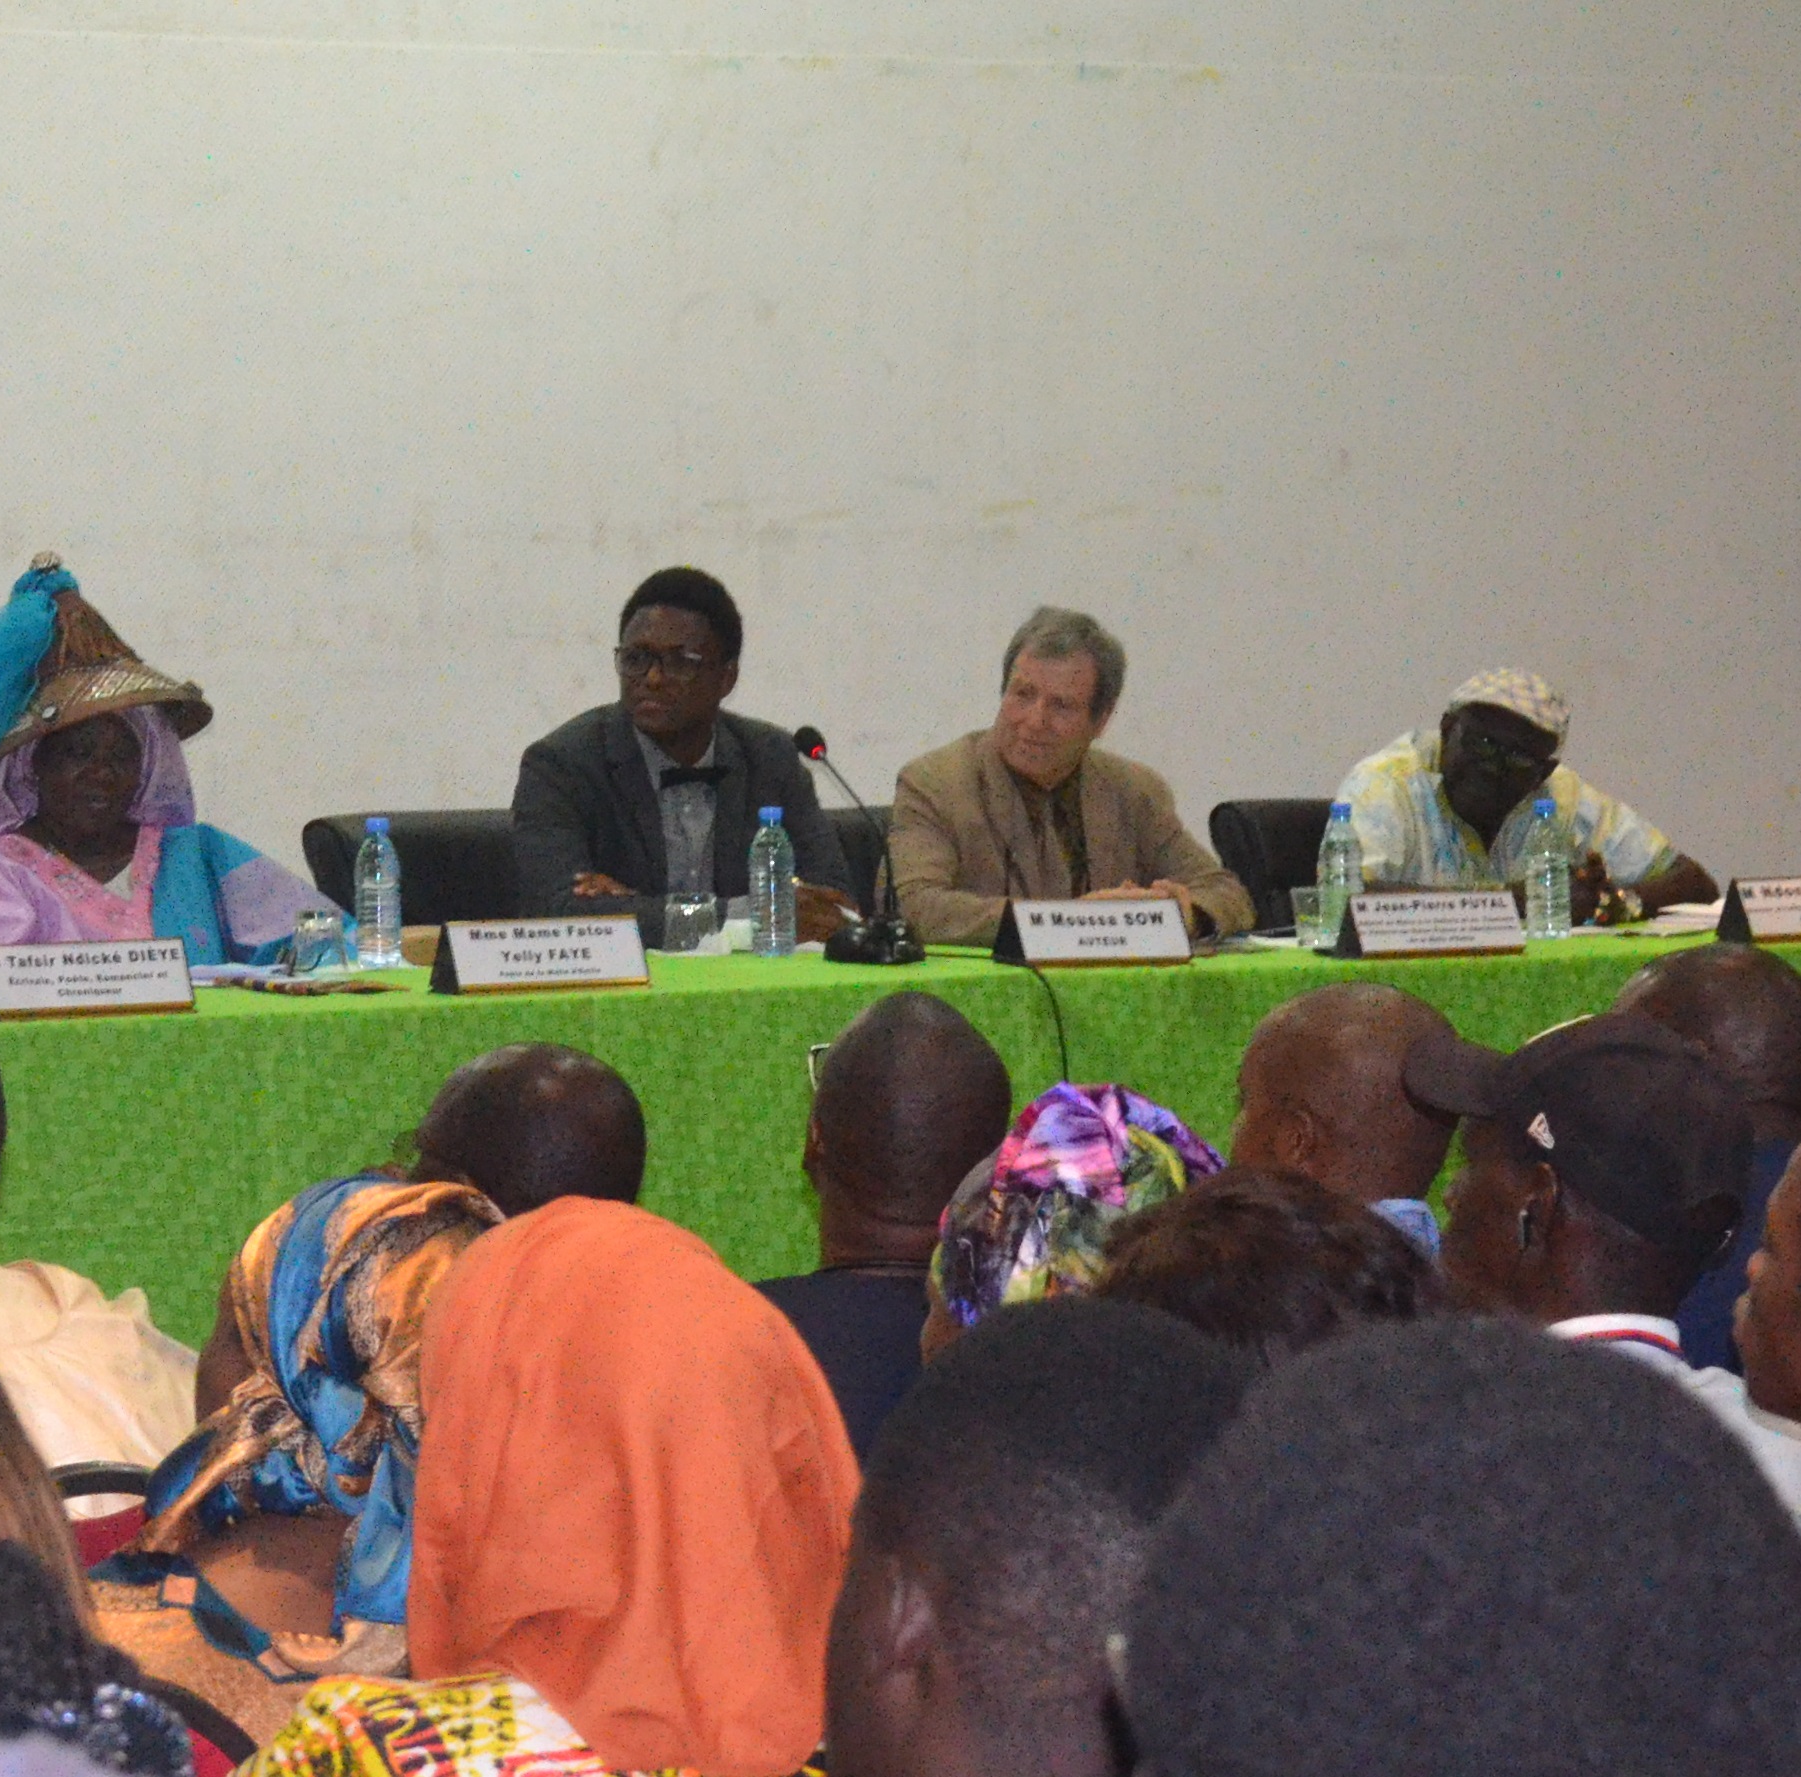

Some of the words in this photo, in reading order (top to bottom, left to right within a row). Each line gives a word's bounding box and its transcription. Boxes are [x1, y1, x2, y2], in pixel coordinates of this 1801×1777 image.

[1030, 912, 1044, 925] M
[1052, 910, 1117, 926] Moussa
[1123, 910, 1164, 925] SOW
[469, 928, 507, 940] Mme
[512, 925, 561, 940] Mame
[567, 923, 613, 937] Fatou
[1078, 935, 1127, 947] AUTEUR
[7, 954, 56, 968] Tafsir
[501, 950, 542, 964] Yelly
[549, 947, 591, 961] FAYE
